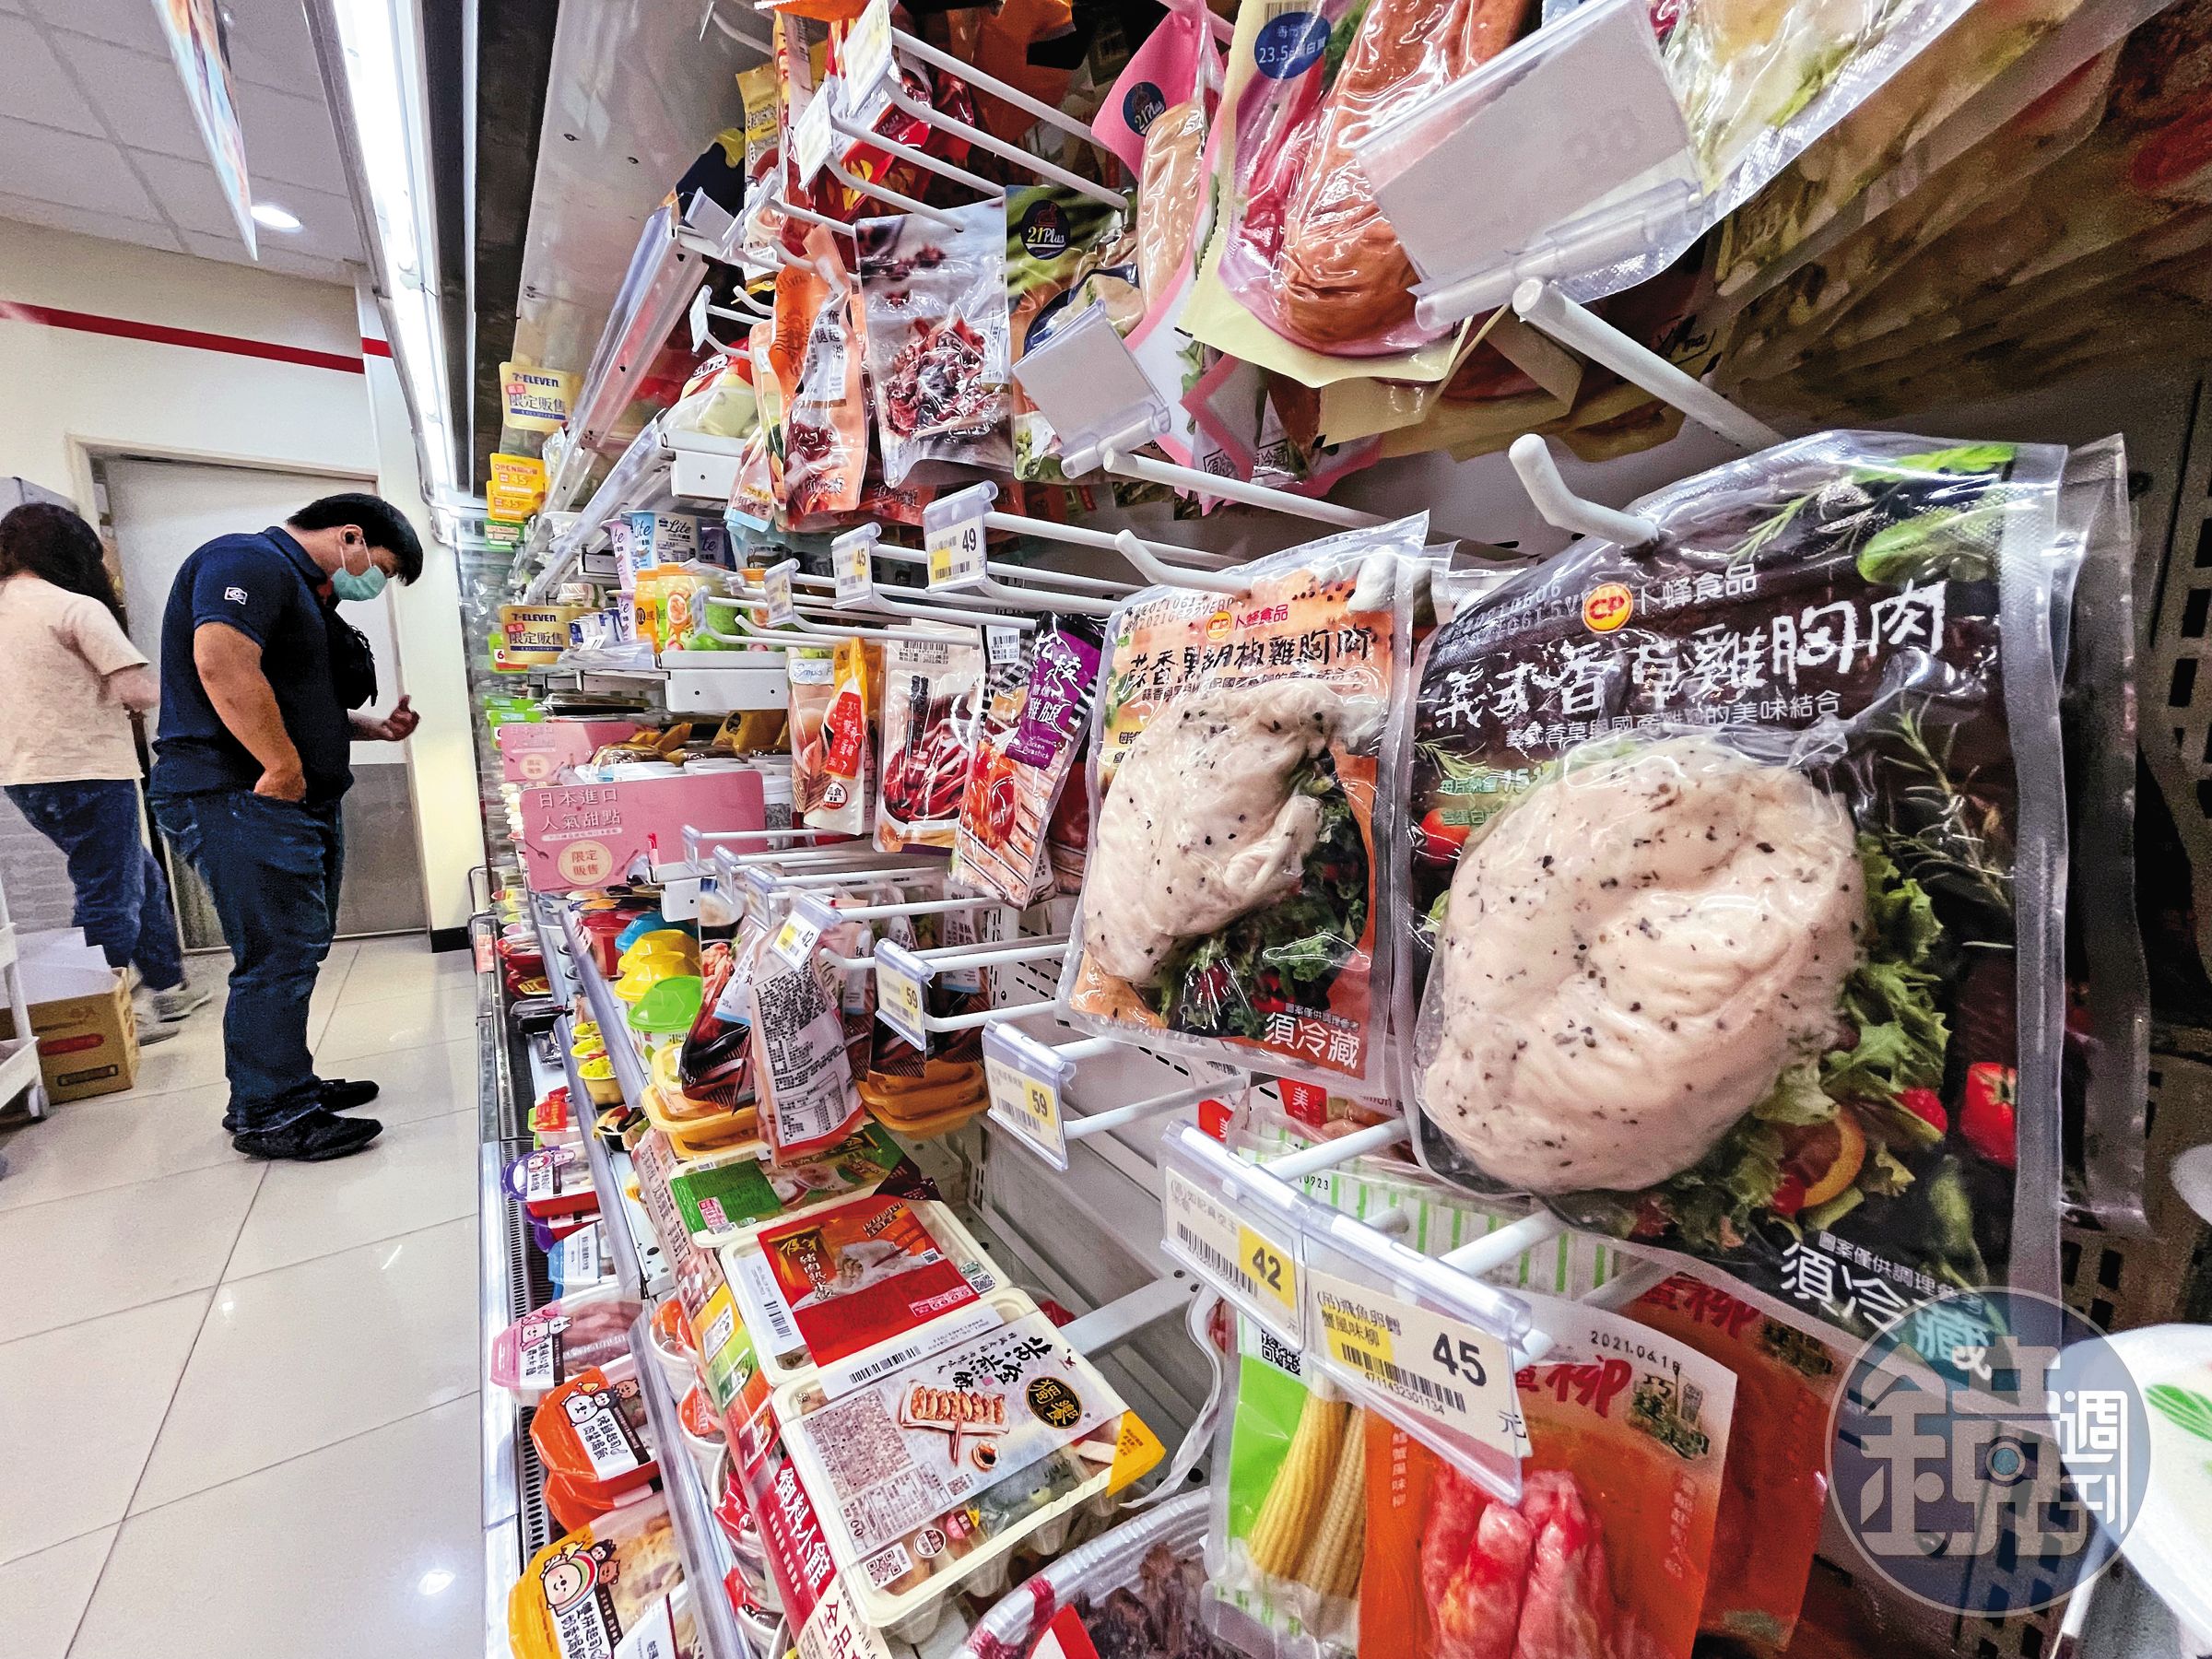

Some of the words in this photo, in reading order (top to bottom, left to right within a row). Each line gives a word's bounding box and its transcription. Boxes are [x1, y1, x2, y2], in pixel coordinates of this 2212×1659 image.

[512, 372, 559, 387] 7-ELEVEN
[510, 394, 565, 413] 限定販售
[962, 528, 977, 552] 49
[855, 551, 866, 568] 45
[1641, 563, 1757, 615] 卜蜂食品
[512, 613, 556, 622] 7-ELEVEN
[1589, 594, 1625, 620] CP
[510, 631, 563, 644] 限定販售
[1028, 697, 1061, 723] 雞腿
[538, 787, 618, 809] 日本進口
[540, 809, 622, 832] 人氣甜點
[571, 849, 598, 863] 限定
[572, 863, 598, 877] 販售
[906, 986, 918, 1009] 59
[1264, 1011, 1360, 1069] 須冷藏
[1031, 1088, 1048, 1117] 59
[1252, 1246, 1283, 1293] 42
[1780, 1241, 1992, 1382] 須冷藏
[1431, 1332, 1488, 1386] 45
[1497, 1411, 1528, 1439] 元
[775, 1466, 831, 1589] 御料小館
